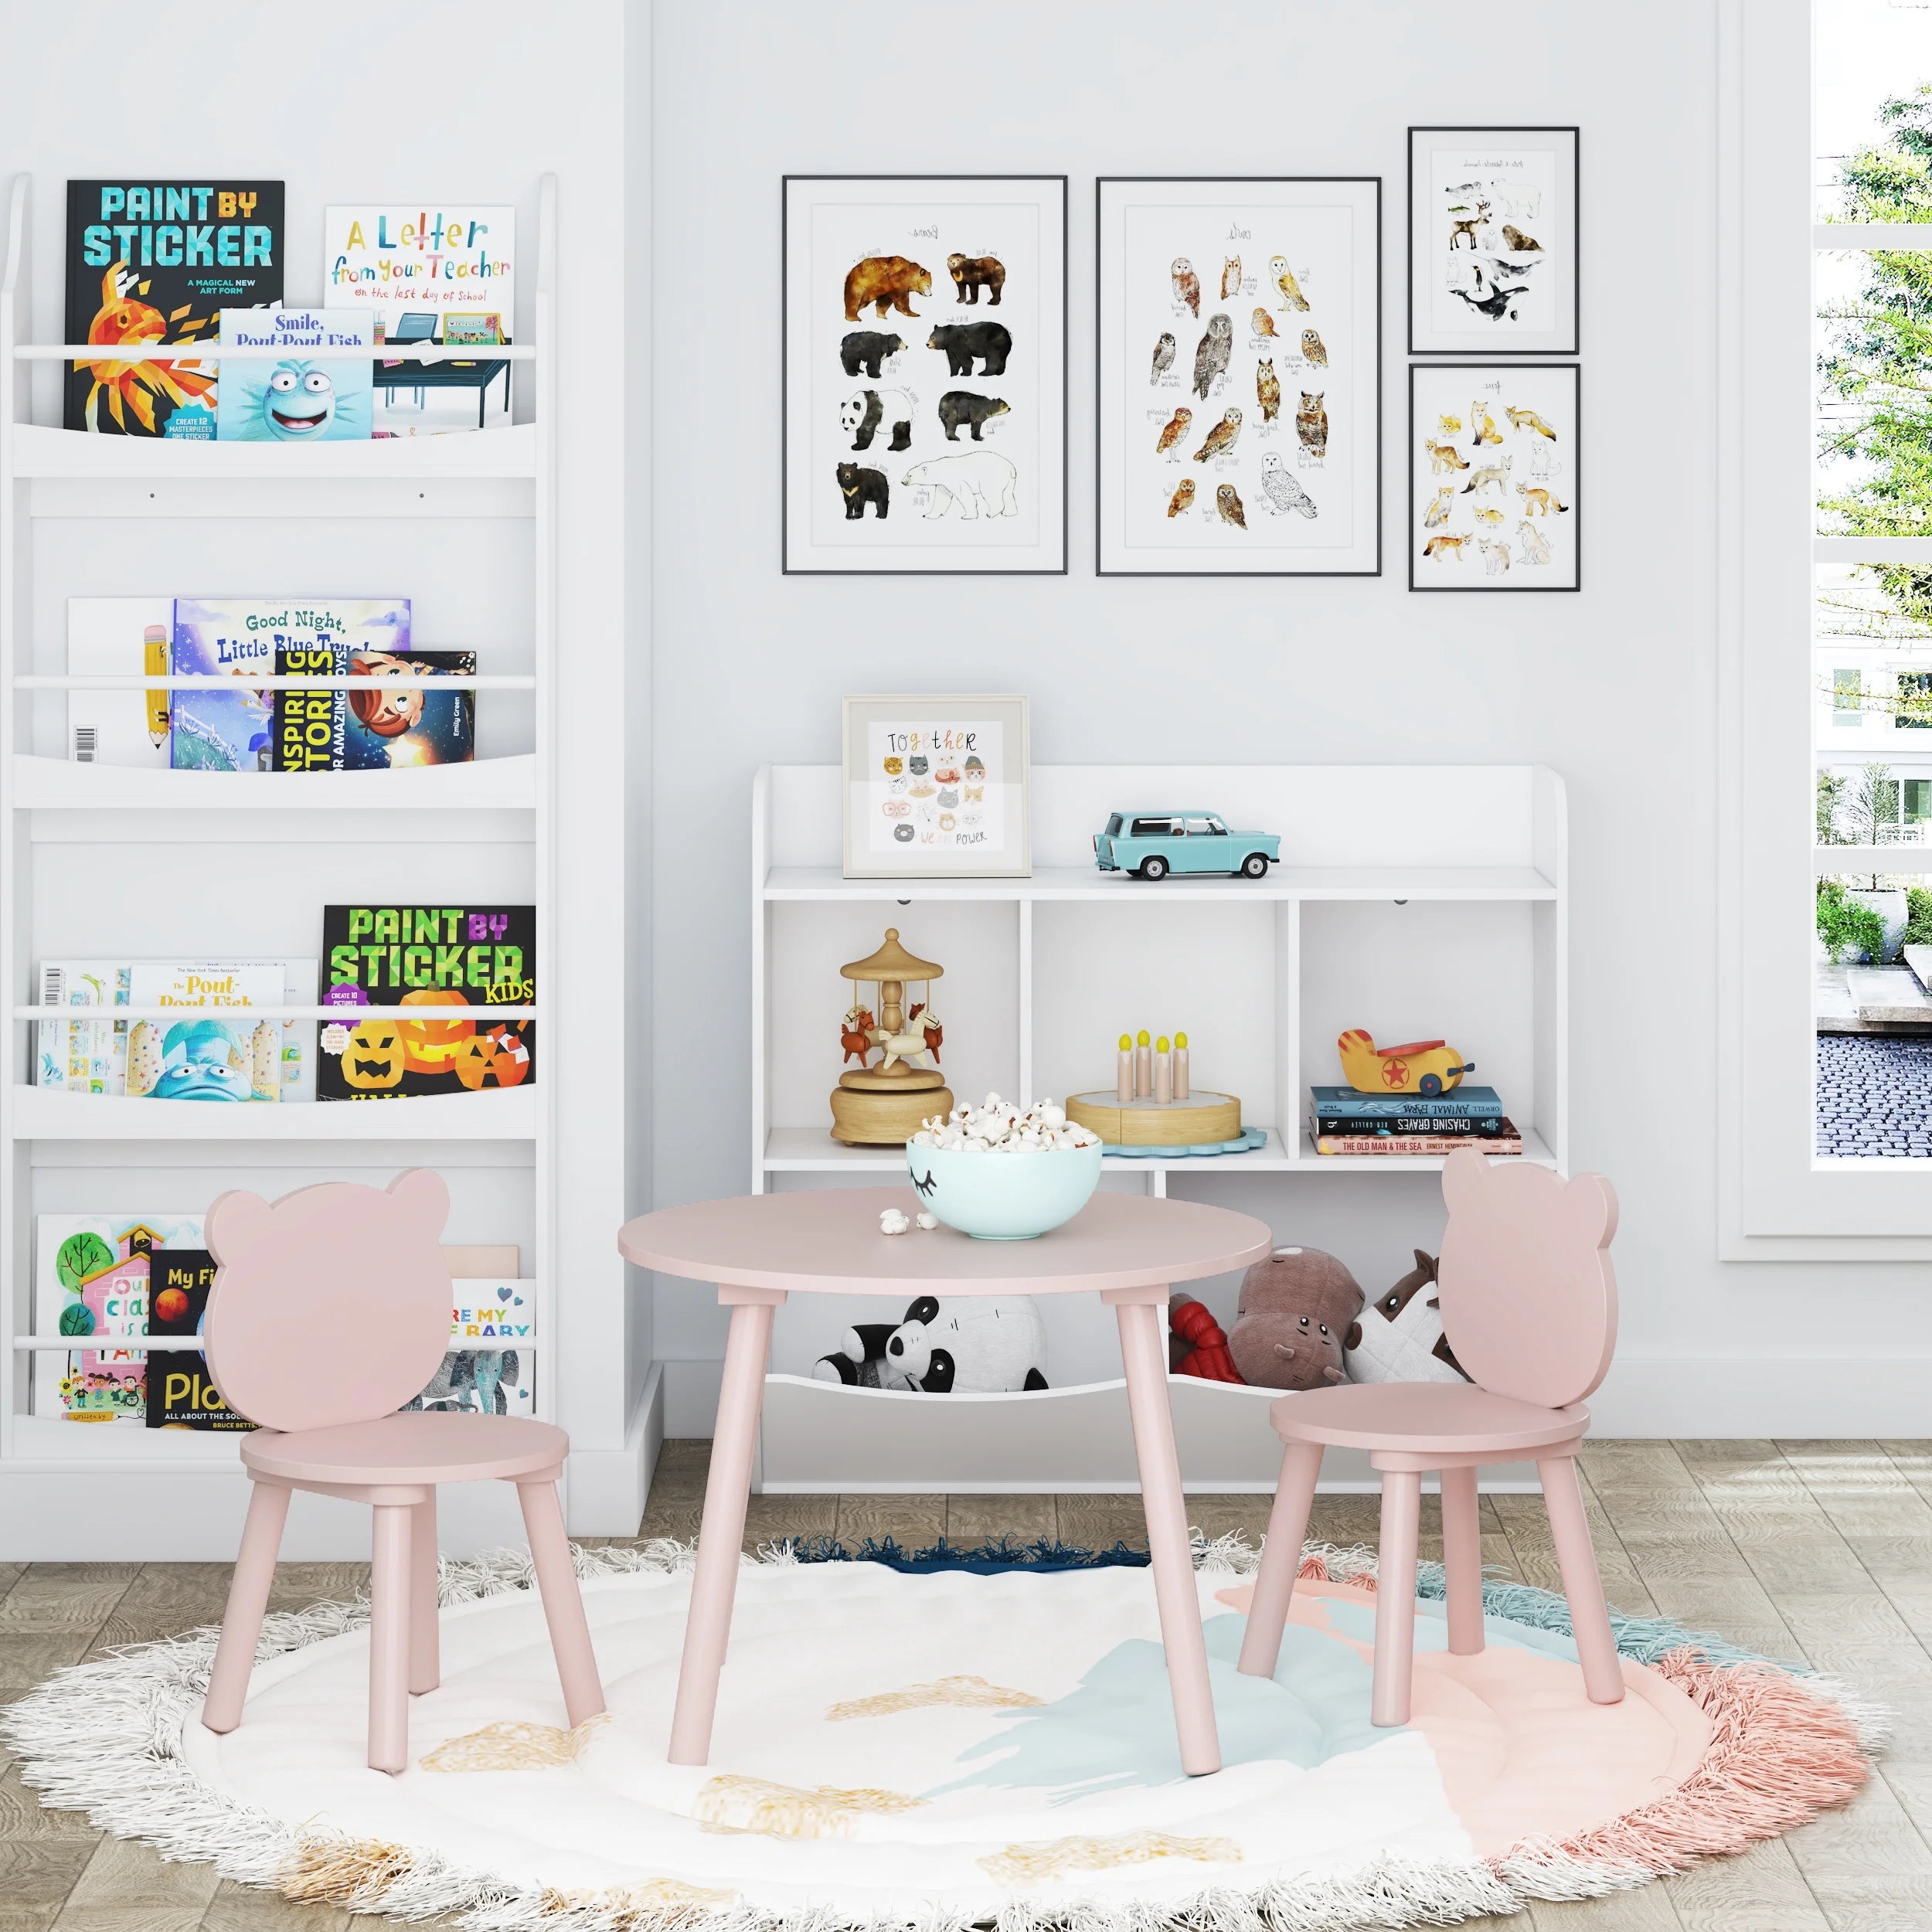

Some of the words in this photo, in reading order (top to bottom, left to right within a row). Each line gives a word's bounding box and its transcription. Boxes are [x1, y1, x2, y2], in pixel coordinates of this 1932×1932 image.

[101, 187, 213, 221] PAINT
[218, 192, 257, 218] BY
[347, 221, 366, 250] A
[379, 213, 488, 250] Letter
[83, 225, 273, 267] STICKER
[332, 256, 376, 285] from
[378, 259, 423, 281] your
[426, 250, 511, 280] Teacher
[372, 287, 389, 299] the
[395, 286, 415, 299] last
[422, 288, 438, 303] day
[443, 290, 454, 302] of
[275, 313, 325, 332] Smile,
[327, 334, 362, 345] Fish
[246, 611, 288, 631] Good
[294, 611, 346, 634] Night,
[216, 638, 268, 664] Little
[274, 634, 314, 651] Blue
[333, 691, 346, 756] AMAZING
[453, 719, 461, 736] Emily
[349, 909, 464, 944] PAINT
[468, 913, 508, 940] BY
[330, 945, 523, 987] STICKER
[185, 976, 240, 995] Pout-
[484, 978, 534, 1004] KIDS
[1403, 1104, 1428, 1114] FARM
[1432, 1104, 1470, 1114] ANIMAL
[1398, 1119, 1430, 1131] GRAVES
[1434, 1119, 1471, 1131] CHASING
[1343, 1142, 1355, 1151] THE
[1356, 1142, 1369, 1151] OLD
[1371, 1142, 1388, 1151] MAN
[1389, 1142, 1394, 1151] &
[1396, 1142, 1406, 1151] THE
[1409, 1142, 1422, 1151] SEA
[168, 1268, 194, 1289] My
[478, 1309, 507, 1322] MY
[466, 1325, 530, 1336] BABY
